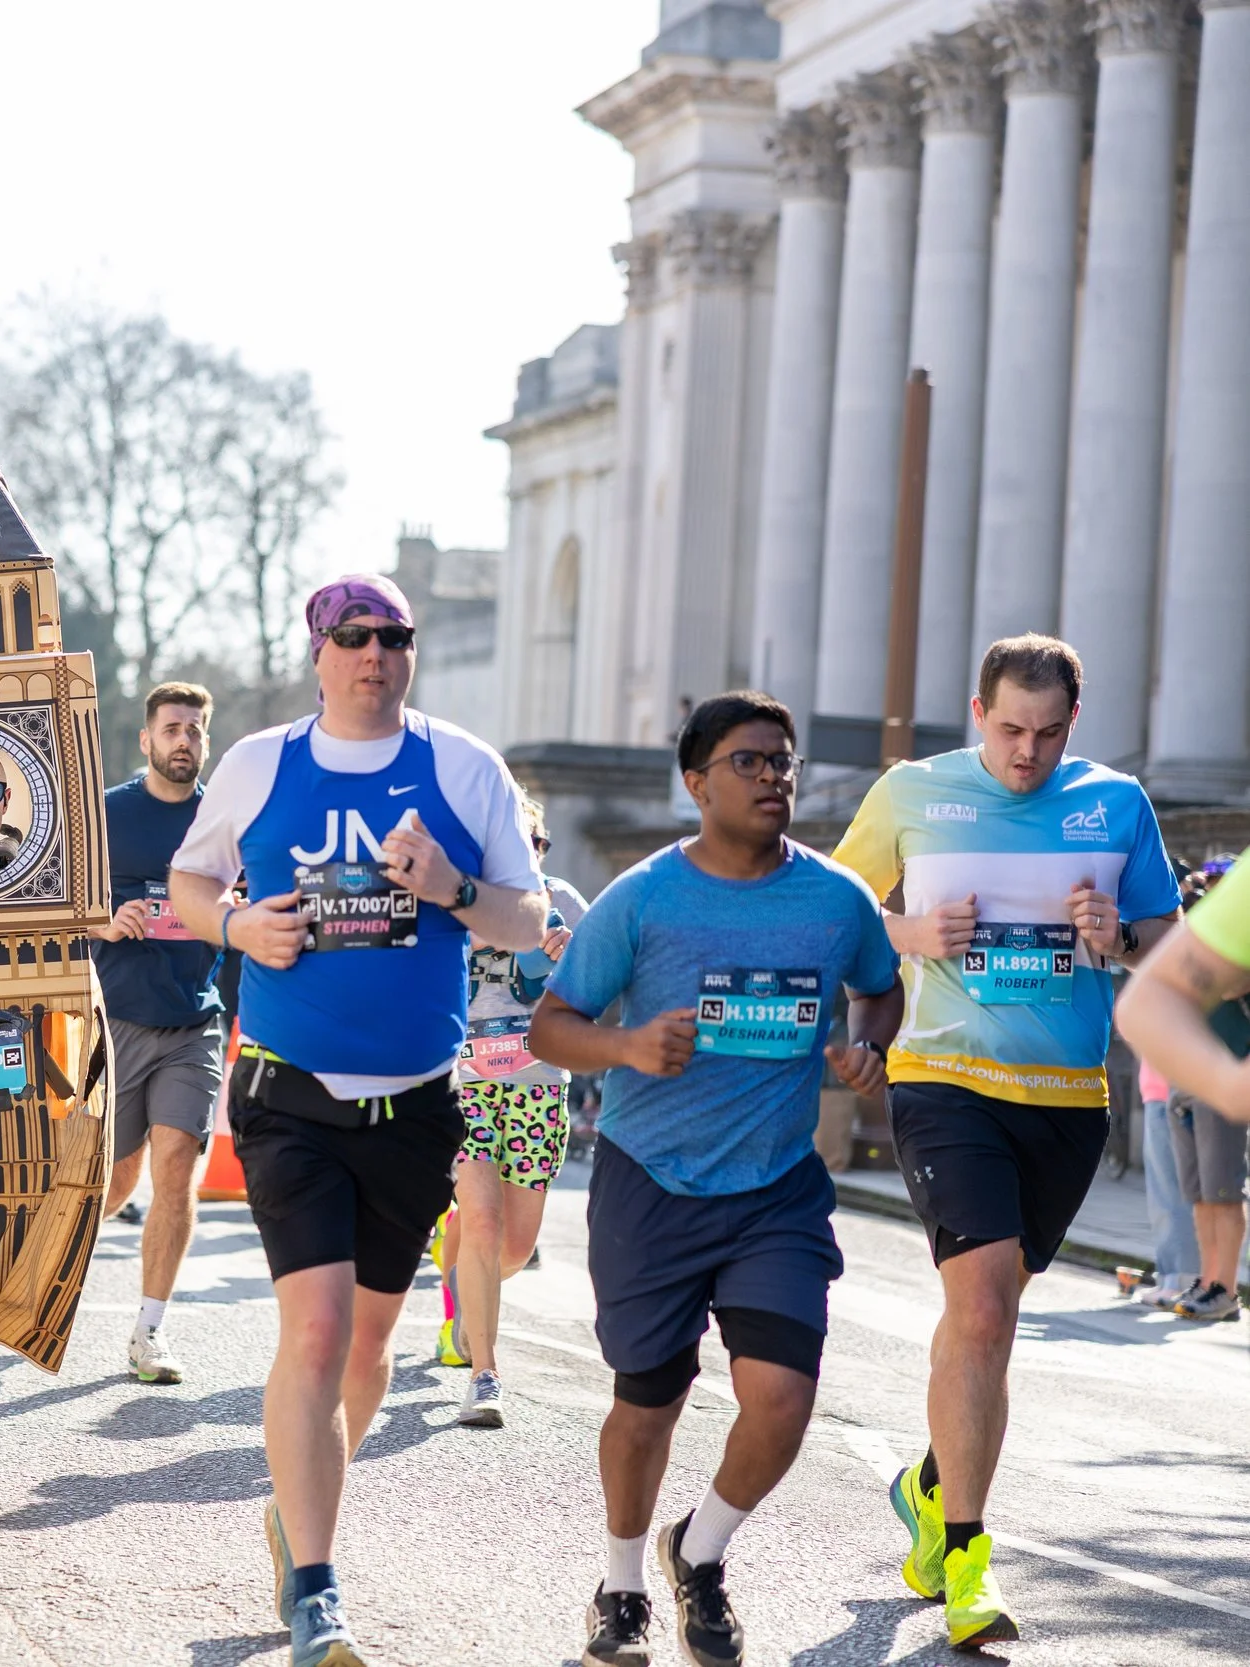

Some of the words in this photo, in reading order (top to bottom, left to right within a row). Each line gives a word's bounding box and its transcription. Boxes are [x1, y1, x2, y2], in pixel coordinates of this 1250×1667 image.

[928, 805, 975, 816] TEAM
[1062, 800, 1107, 829] act
[322, 896, 390, 915] V.17007
[323, 920, 390, 935] STEPHEN
[993, 956, 1047, 970] H.8921
[994, 978, 1047, 989] ROBERT
[726, 1005, 796, 1021] H.13122
[718, 1026, 799, 1041] DESHRAAM
[480, 1040, 519, 1055] J.7385
[487, 1056, 513, 1067] NIKKI
